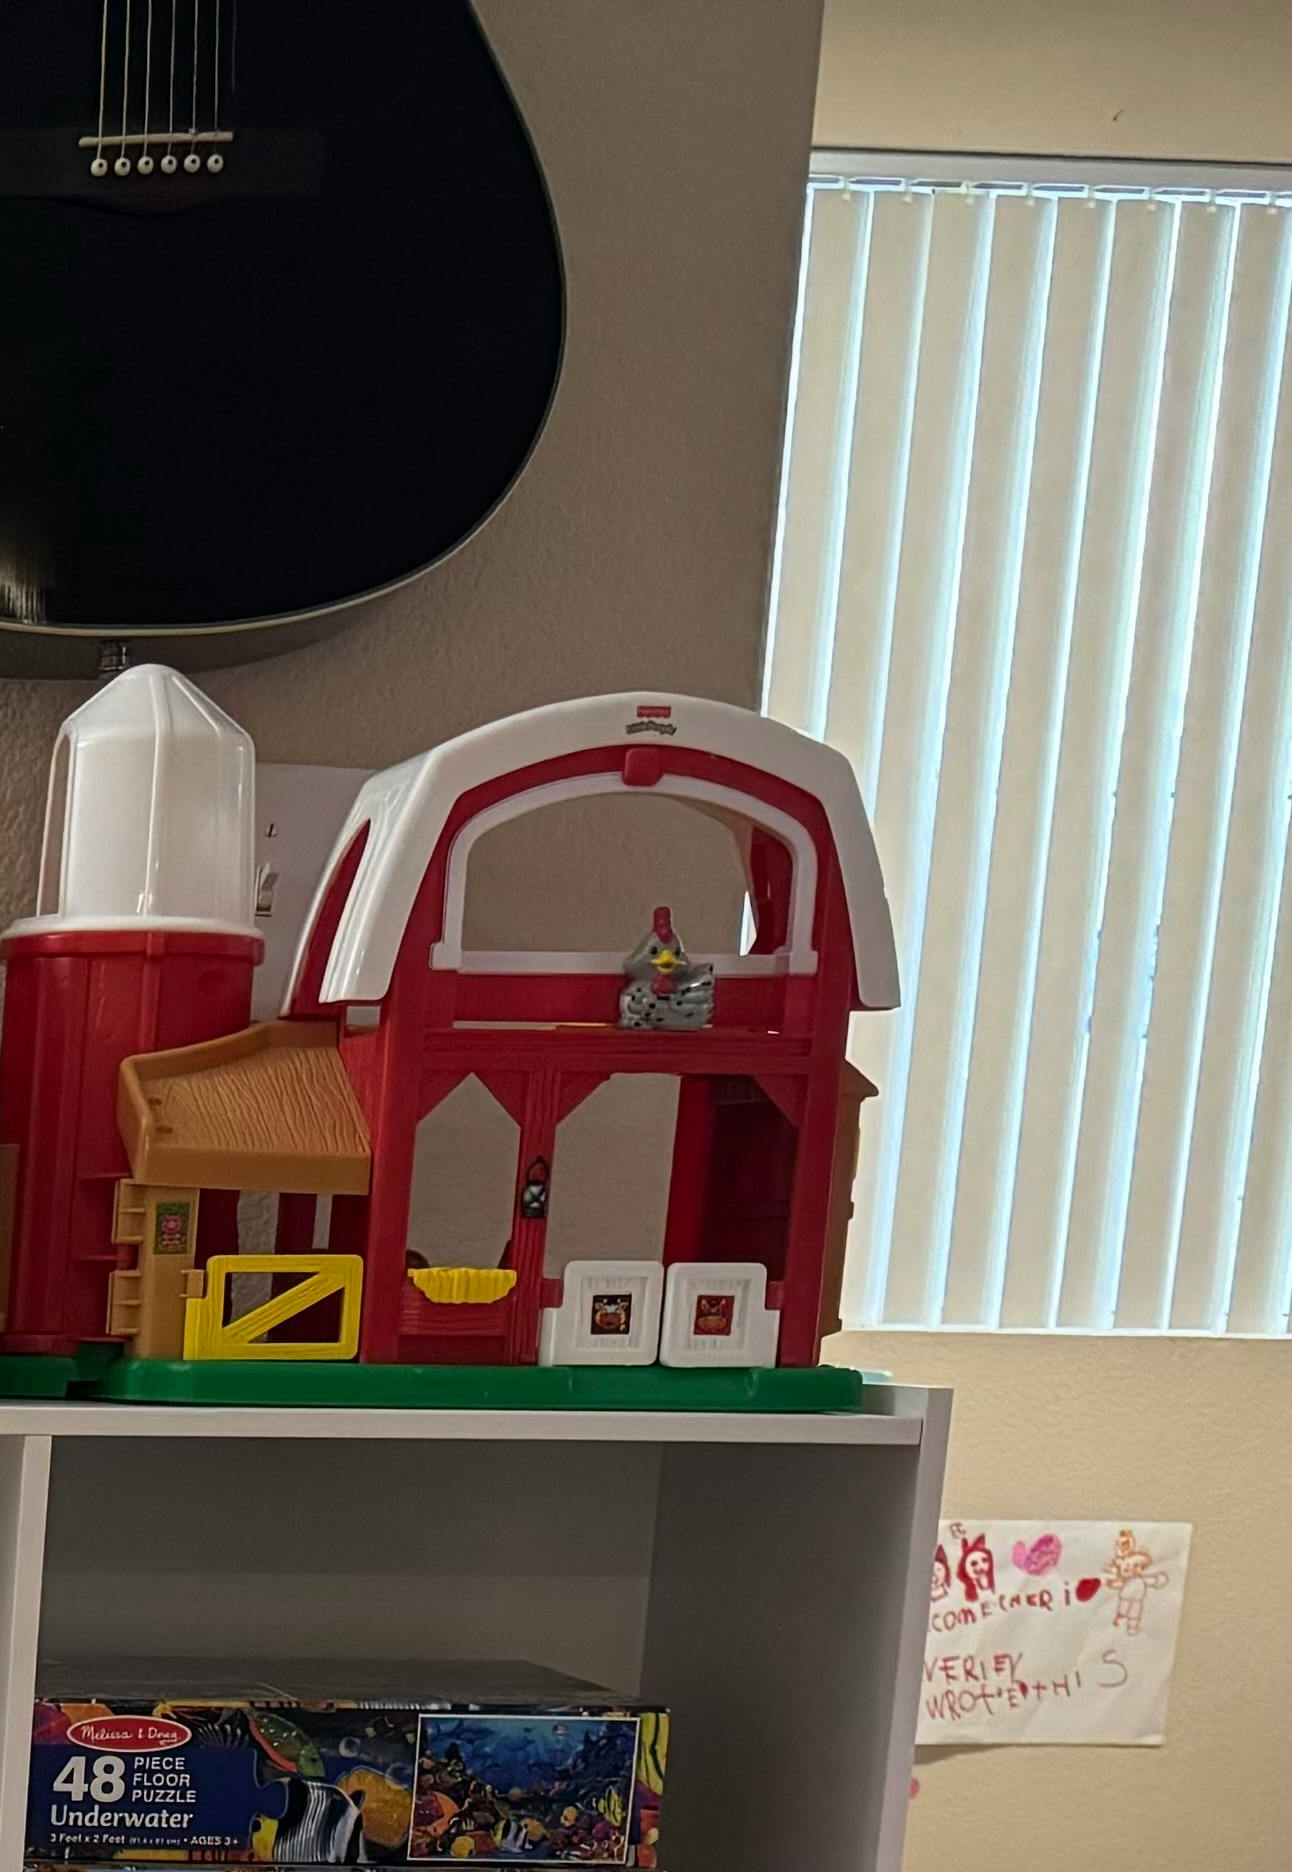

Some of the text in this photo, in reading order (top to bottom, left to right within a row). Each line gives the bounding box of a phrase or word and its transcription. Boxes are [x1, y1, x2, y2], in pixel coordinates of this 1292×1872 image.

[133, 1756, 186, 1770] PIECE
[52, 1755, 127, 1803] 48
[132, 1773, 191, 1787] FLOOR
[131, 1790, 197, 1803] PUZZLE
[50, 1804, 194, 1829] Underwater
[59, 1833, 82, 1843] Feet
[93, 1834, 100, 1843] 2
[102, 1834, 126, 1844] Feet
[189, 1835, 223, 1846] AGES
